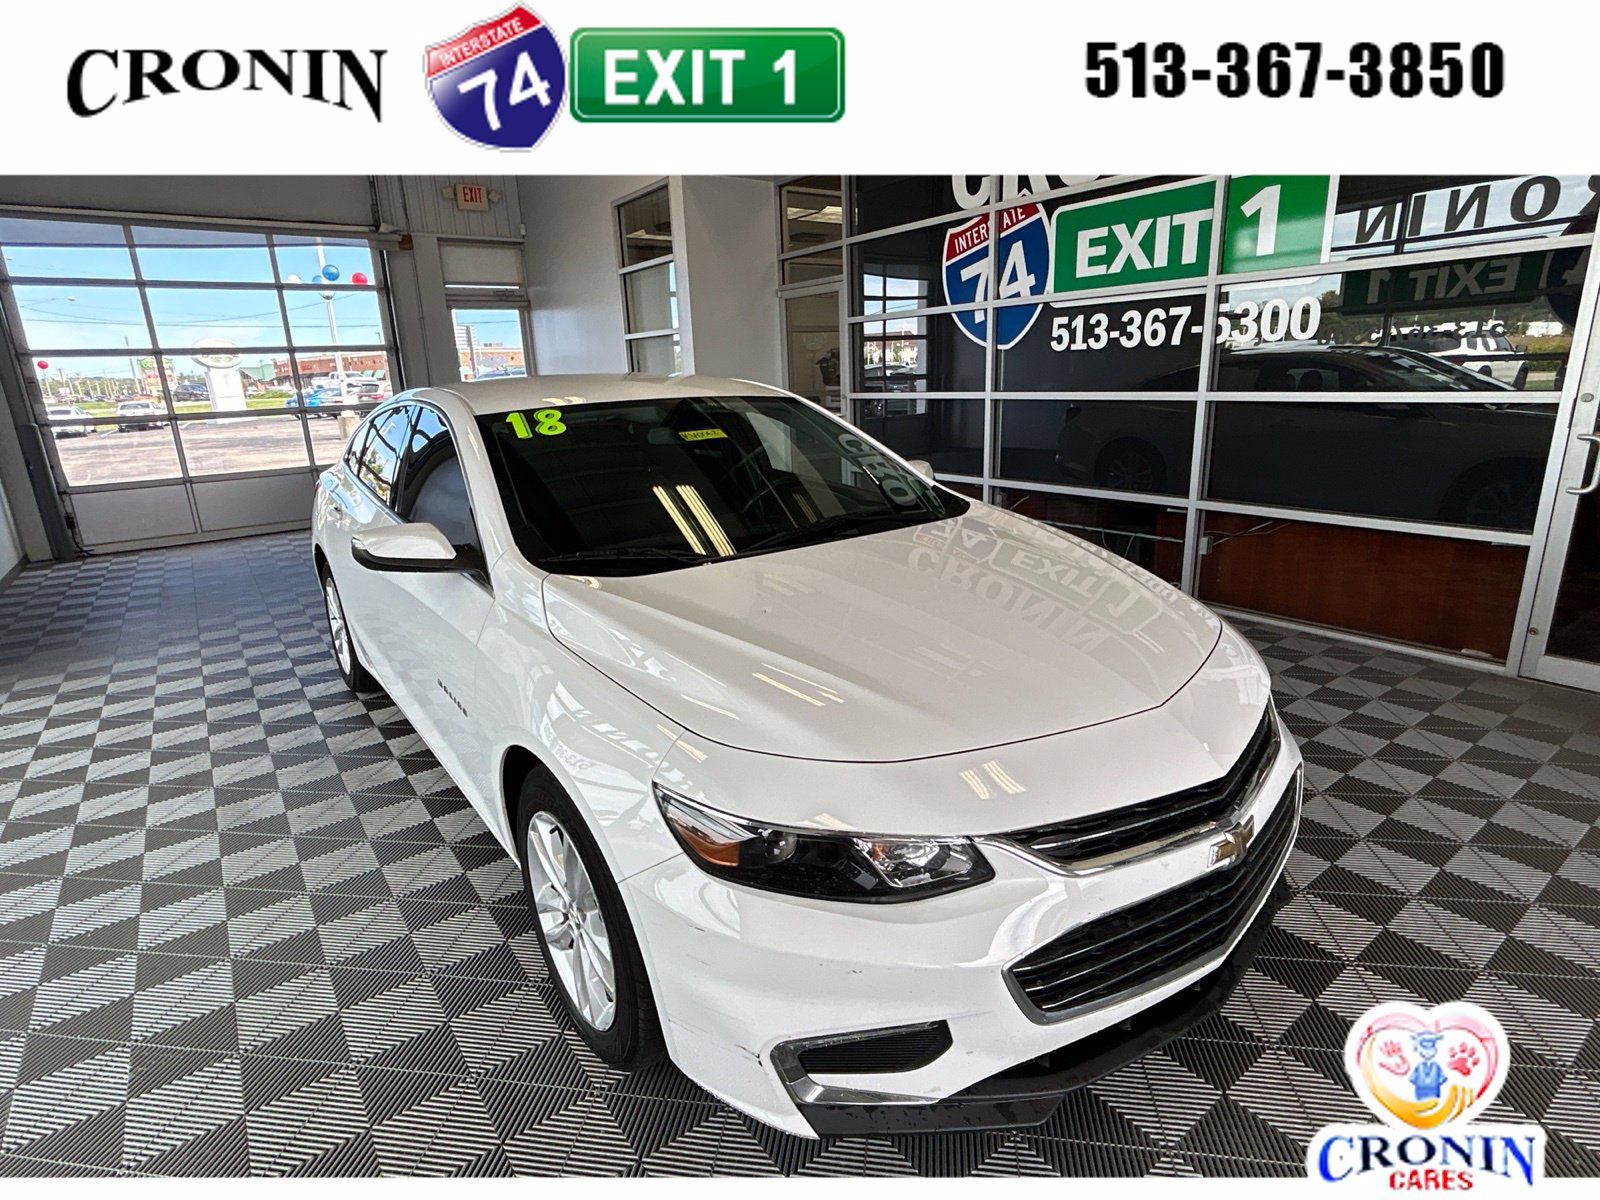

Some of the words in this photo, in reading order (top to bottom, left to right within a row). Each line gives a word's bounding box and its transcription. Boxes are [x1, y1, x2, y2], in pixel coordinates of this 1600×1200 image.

[462, 186, 482, 203] EXIT
[1075, 207, 1214, 279] EXIT
[1240, 183, 1282, 257] 1
[960, 239, 1037, 325] 74
[1049, 296, 1322, 353] 513-367-5300
[505, 409, 567, 438] 18
